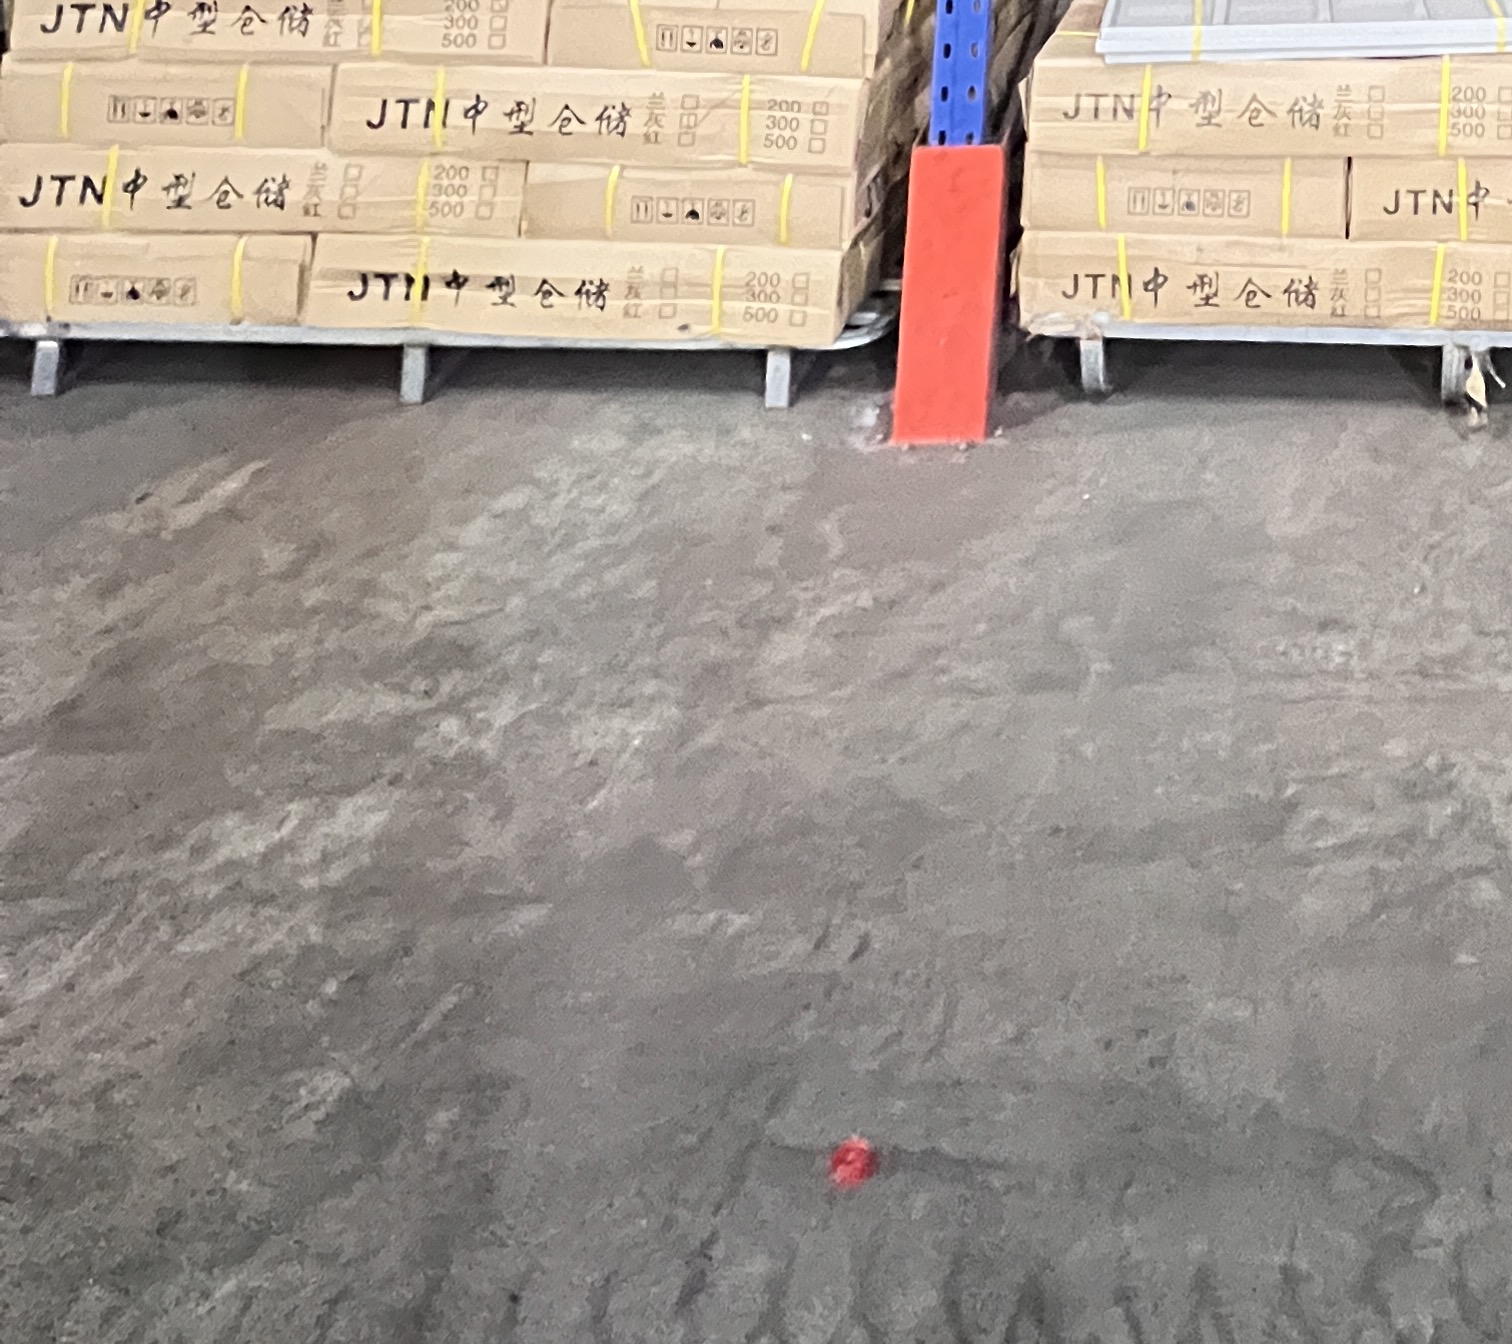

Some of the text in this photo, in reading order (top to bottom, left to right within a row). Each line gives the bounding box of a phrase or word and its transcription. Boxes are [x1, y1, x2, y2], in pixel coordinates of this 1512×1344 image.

[40, 3, 130, 34] JTN
[442, 33, 477, 48] 500
[1451, 86, 1486, 102] 200
[767, 98, 801, 114] 200
[1063, 84, 1325, 130] JTN 中型仓储
[367, 94, 632, 137] JTN 中型仓储
[766, 116, 799, 132] 300
[1449, 122, 1486, 138] 500
[763, 134, 798, 150] 500
[434, 166, 469, 180] 200
[18, 168, 292, 212] JTN 中型仓储
[431, 183, 468, 198] 300
[428, 202, 464, 217] 500
[1383, 189, 1454, 216] JTN
[745, 271, 781, 289] 200
[1448, 271, 1482, 286] 200
[348, 273, 429, 302] JTN
[1063, 267, 1320, 310] JTN 中型仓储
[1446, 288, 1482, 303] 300
[742, 307, 778, 323] 500
[1445, 305, 1481, 320] 500
